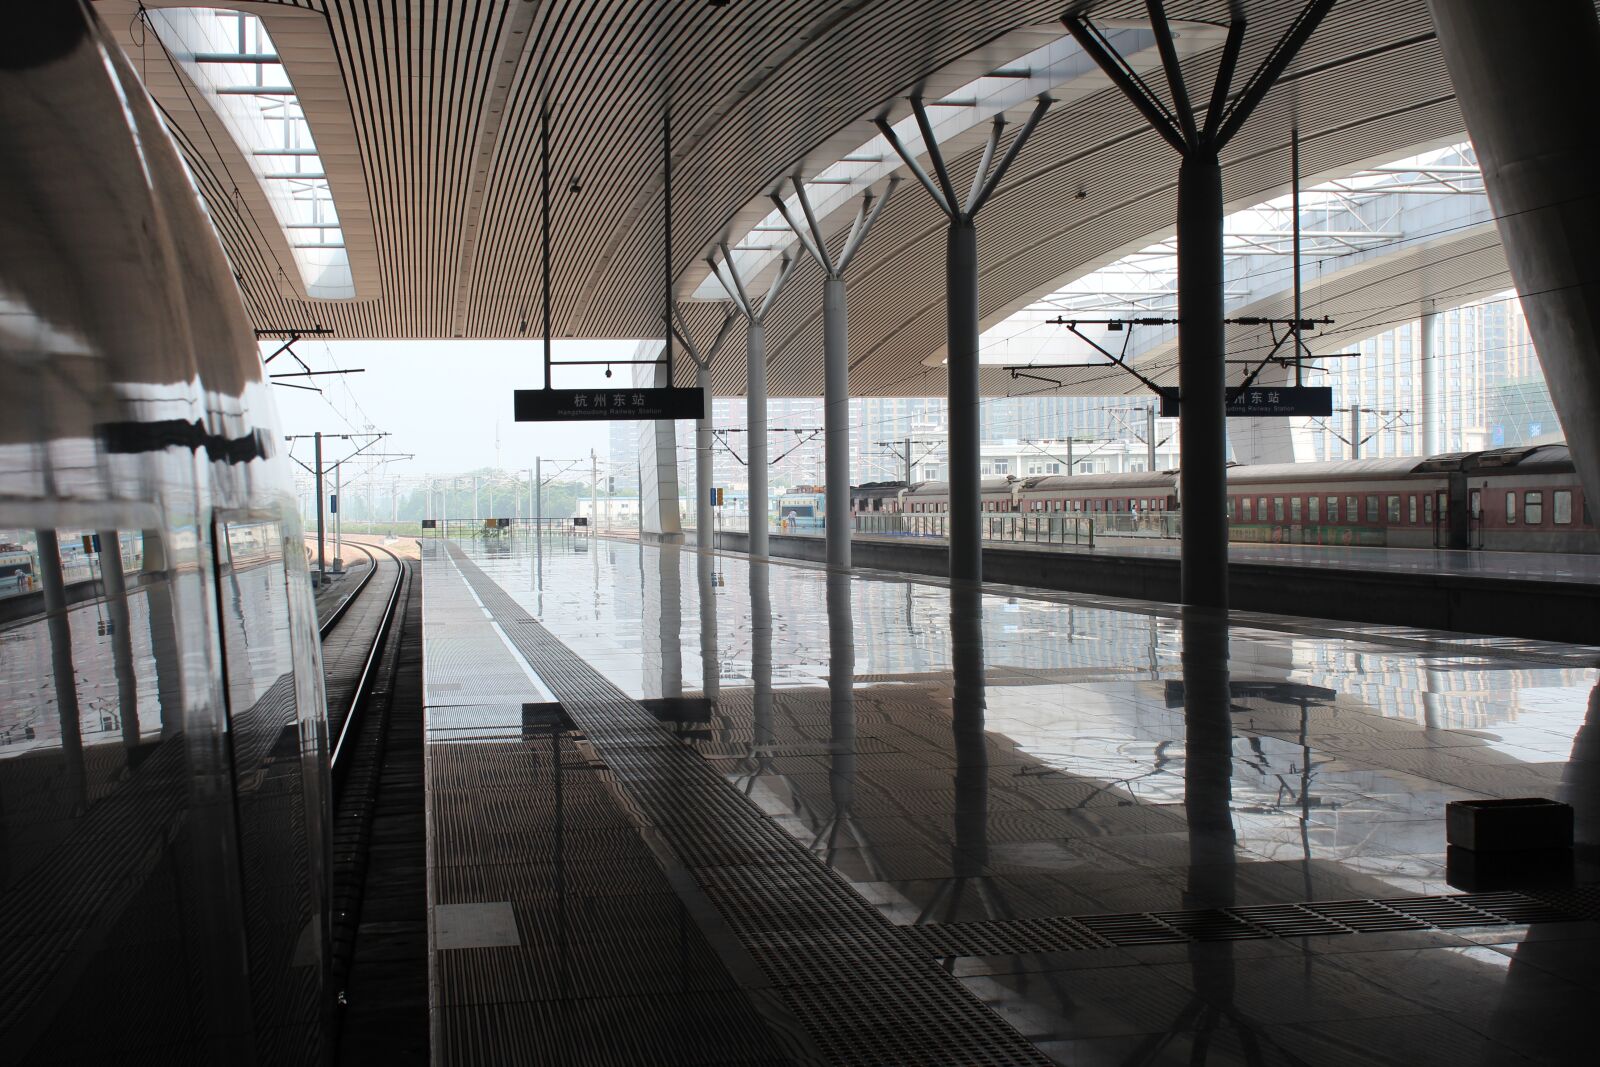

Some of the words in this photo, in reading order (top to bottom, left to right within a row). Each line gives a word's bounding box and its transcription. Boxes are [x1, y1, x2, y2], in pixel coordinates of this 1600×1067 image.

[574, 393, 645, 407] 杭州东站
[1225, 392, 1280, 404] 州东站
[610, 408, 635, 416] Railway
